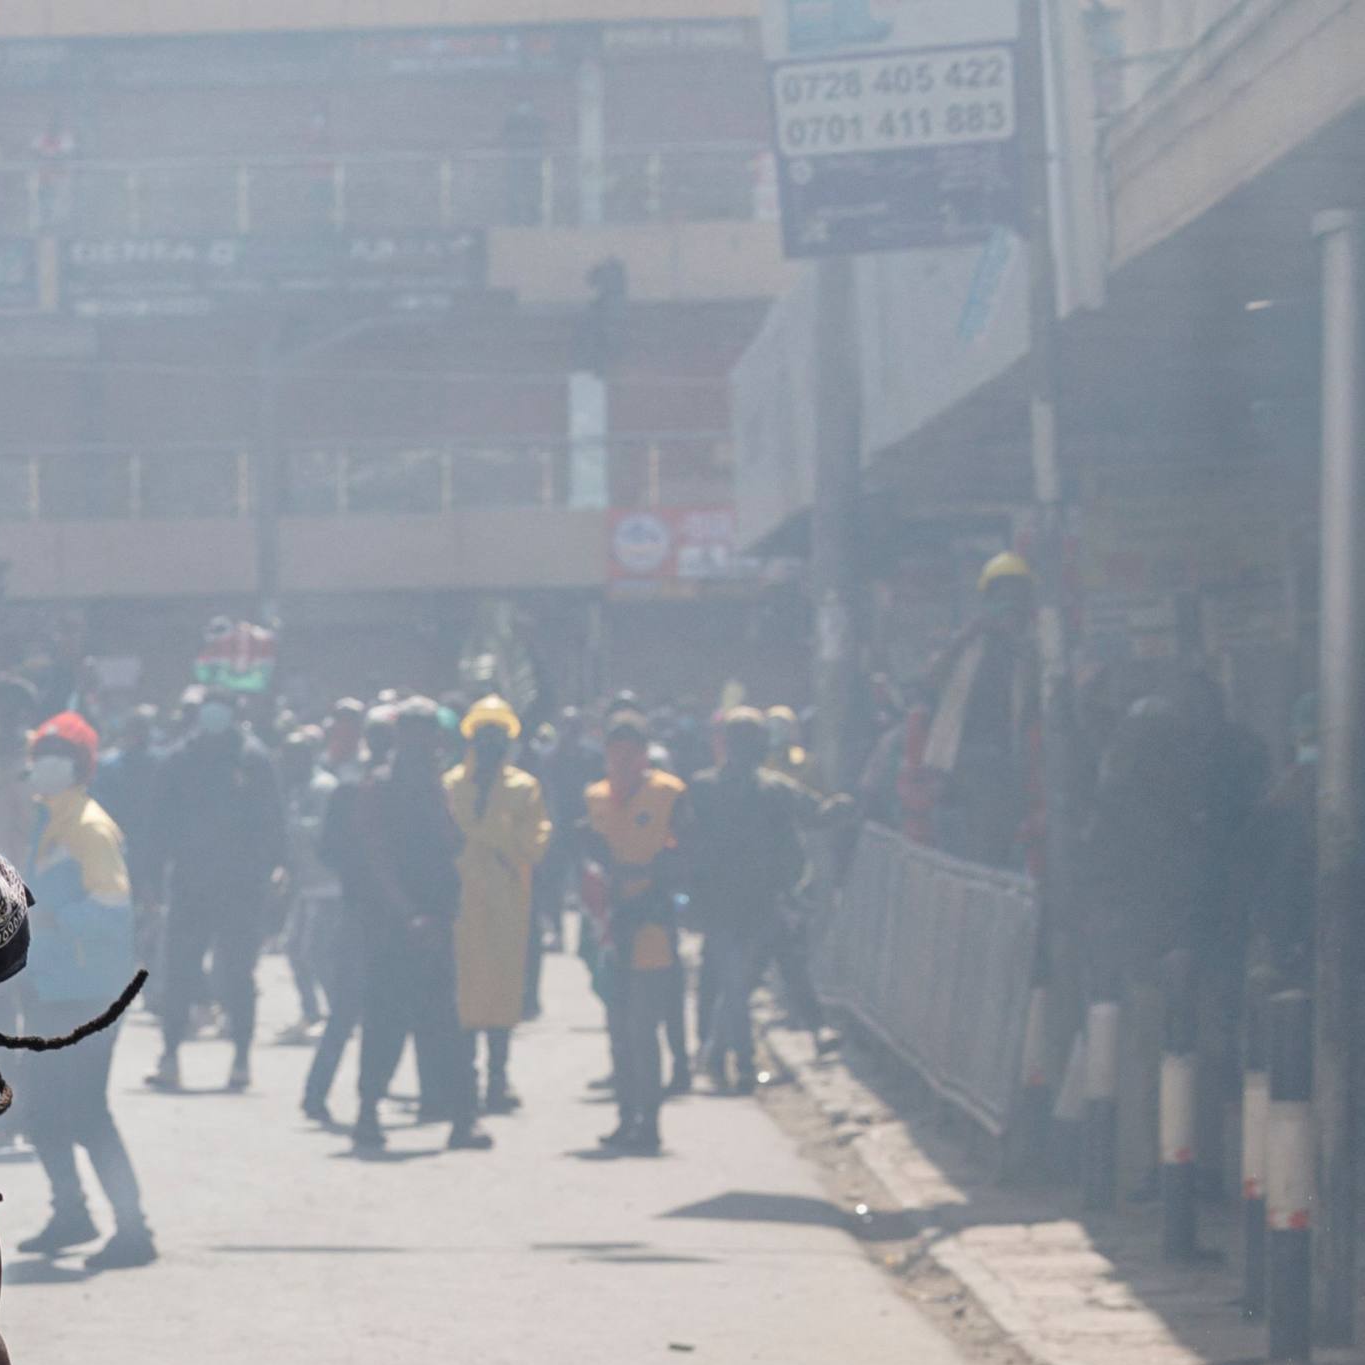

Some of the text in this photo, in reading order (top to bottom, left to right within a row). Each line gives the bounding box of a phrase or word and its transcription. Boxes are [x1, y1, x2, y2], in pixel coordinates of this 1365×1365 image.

[873, 63, 935, 94] 405
[944, 54, 1004, 88] 422
[786, 101, 1006, 147] 0701 411 883
